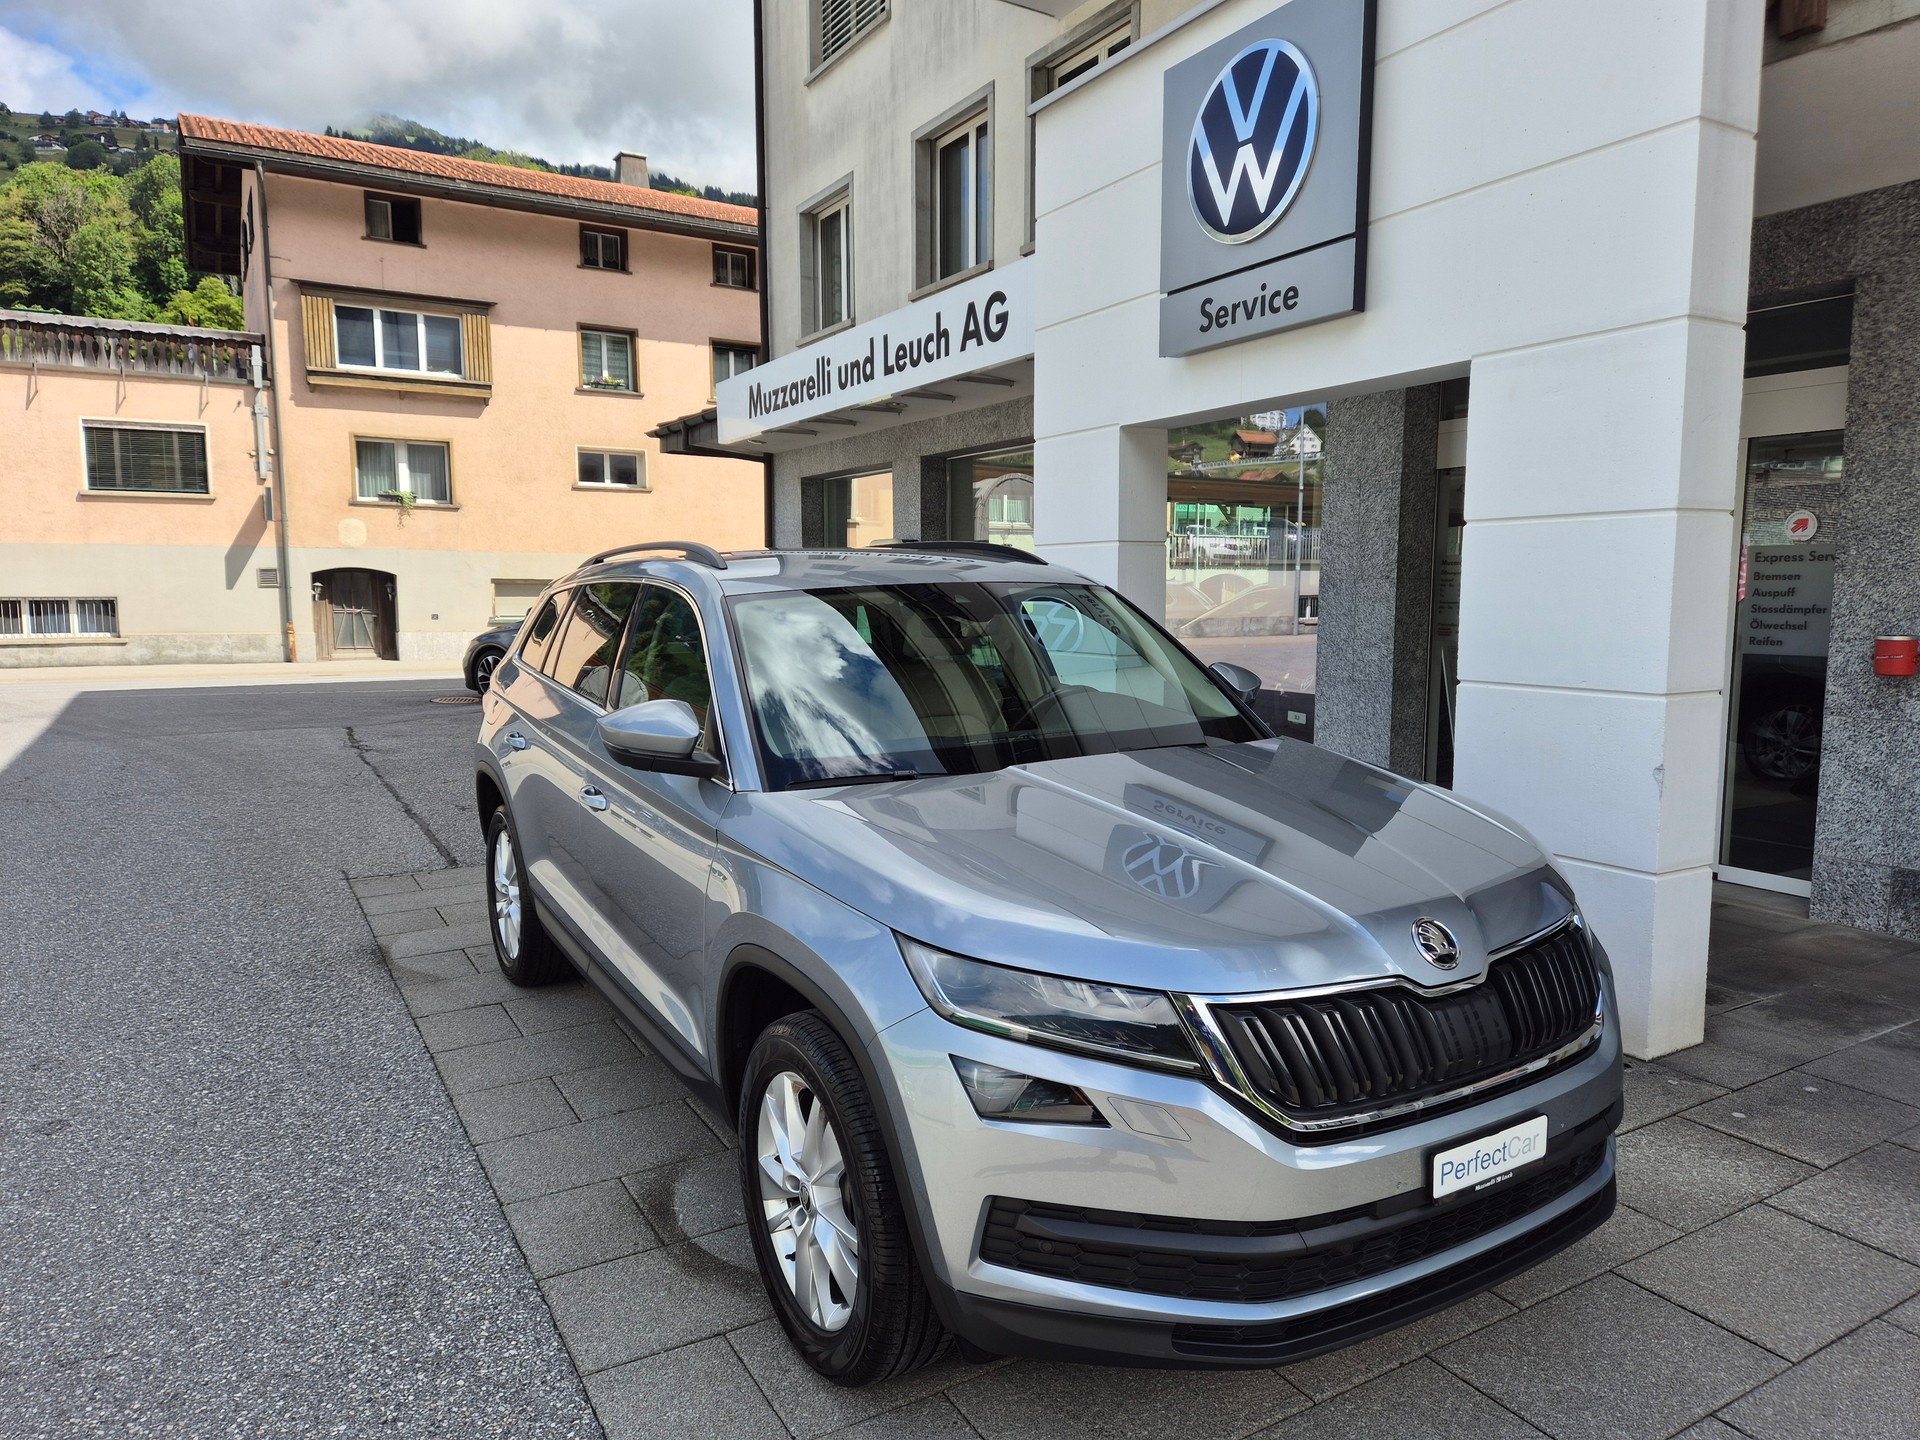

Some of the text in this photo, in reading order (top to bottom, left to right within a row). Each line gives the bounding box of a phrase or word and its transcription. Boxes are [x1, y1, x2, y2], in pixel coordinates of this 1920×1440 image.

[1199, 282, 1299, 333] Service
[748, 290, 1010, 420] Muzzarelli und Leuch AG
[1754, 551, 1804, 565] Express
[1753, 571, 1801, 581] Bremsen
[1752, 587, 1796, 600] Auspuff
[1750, 603, 1828, 616] Stossdämpfer
[1749, 618, 1808, 631] Ölwechsel
[1748, 636, 1783, 647] Reifen
[1440, 1132, 1540, 1187] PerfectCar
